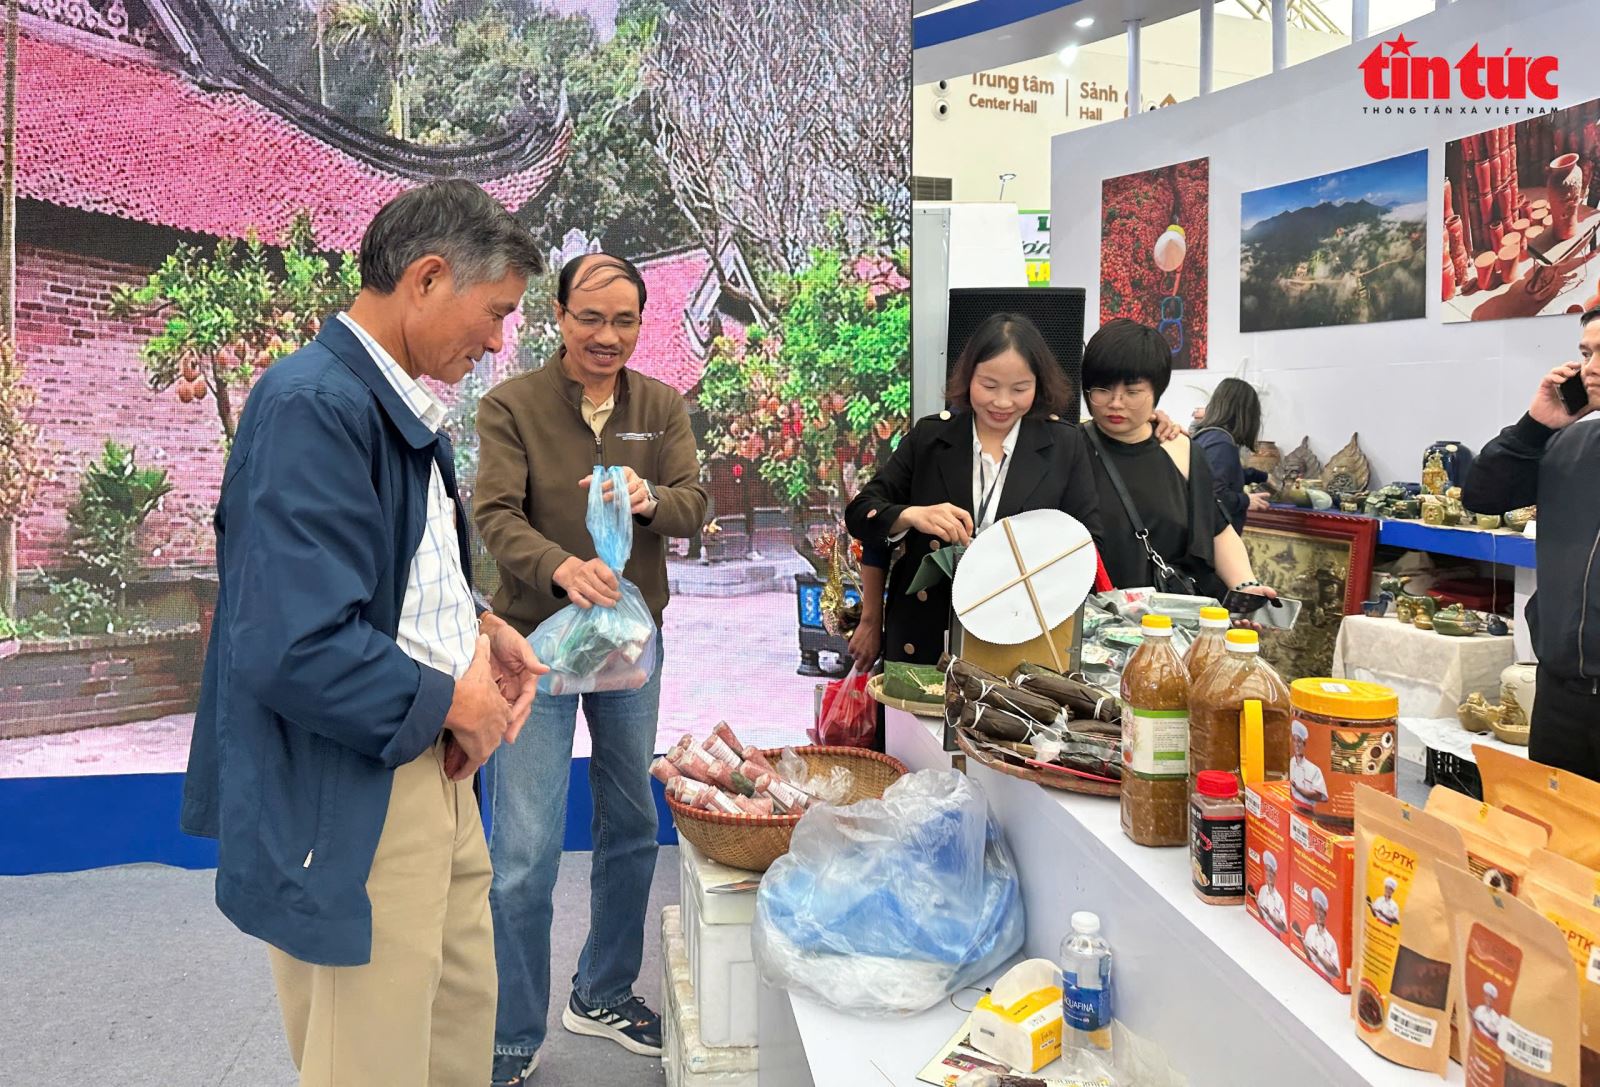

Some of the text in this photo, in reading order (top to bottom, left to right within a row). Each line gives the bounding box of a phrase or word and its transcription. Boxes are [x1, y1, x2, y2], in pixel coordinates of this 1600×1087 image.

[971, 73, 1055, 95] Trung tâm
[1080, 82, 1118, 103] Sảnh
[968, 93, 1038, 114] Center Hall
[1079, 106, 1103, 121] Hall
[1392, 851, 1415, 871] PTK
[1567, 930, 1595, 953] PTK
